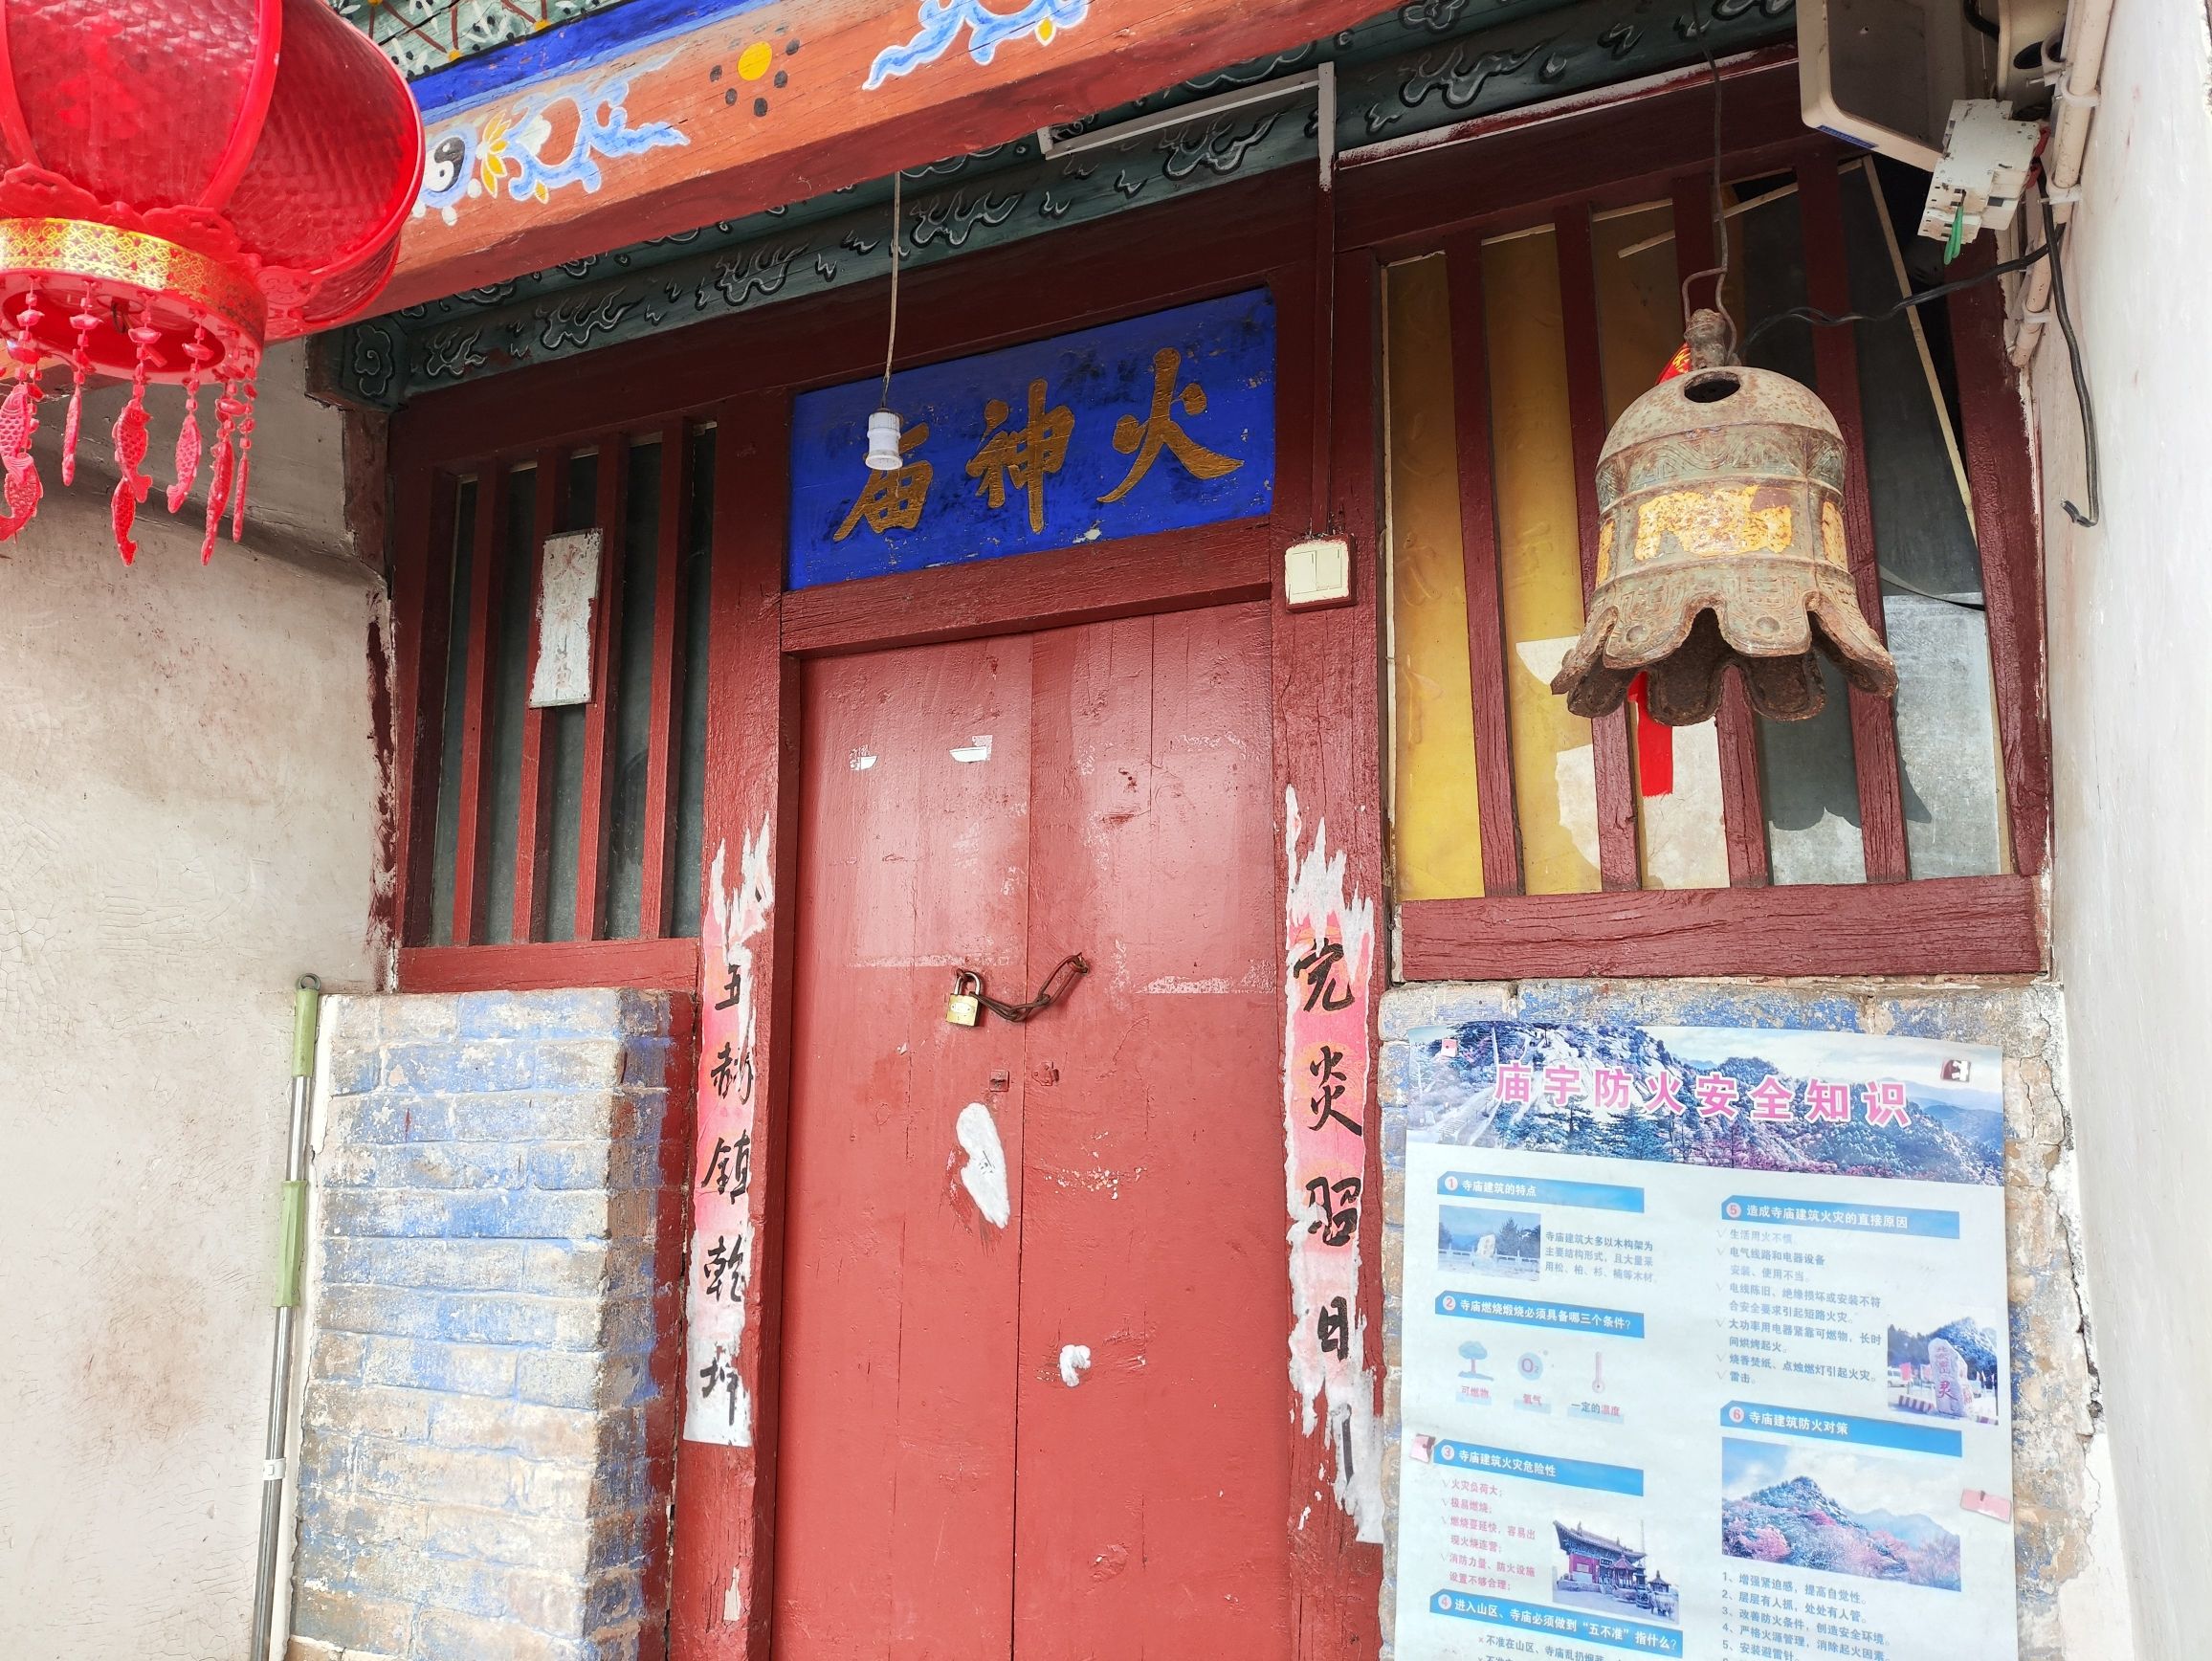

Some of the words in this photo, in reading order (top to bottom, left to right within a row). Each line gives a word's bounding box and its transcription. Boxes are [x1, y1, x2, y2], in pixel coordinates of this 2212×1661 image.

[1493, 1061, 1913, 1129] 庙宇防火安全知识
[1461, 1179, 1537, 1197] 寺庙建筑的特点
[1746, 1205, 1909, 1229] 造成寺庙建筑火灾的直接原因
[1545, 1231, 1653, 1251] 寺庙建筑大多以木构架为
[1730, 1247, 1825, 1266] 电气线路和电器设备
[1461, 1385, 1490, 1399] 可燃物
[1571, 1402, 1621, 1417] 一定的温度
[1749, 1410, 1848, 1435] 寺庙建筑防火对策
[1459, 1450, 1557, 1476] 寺庙建筑火灾危险性
